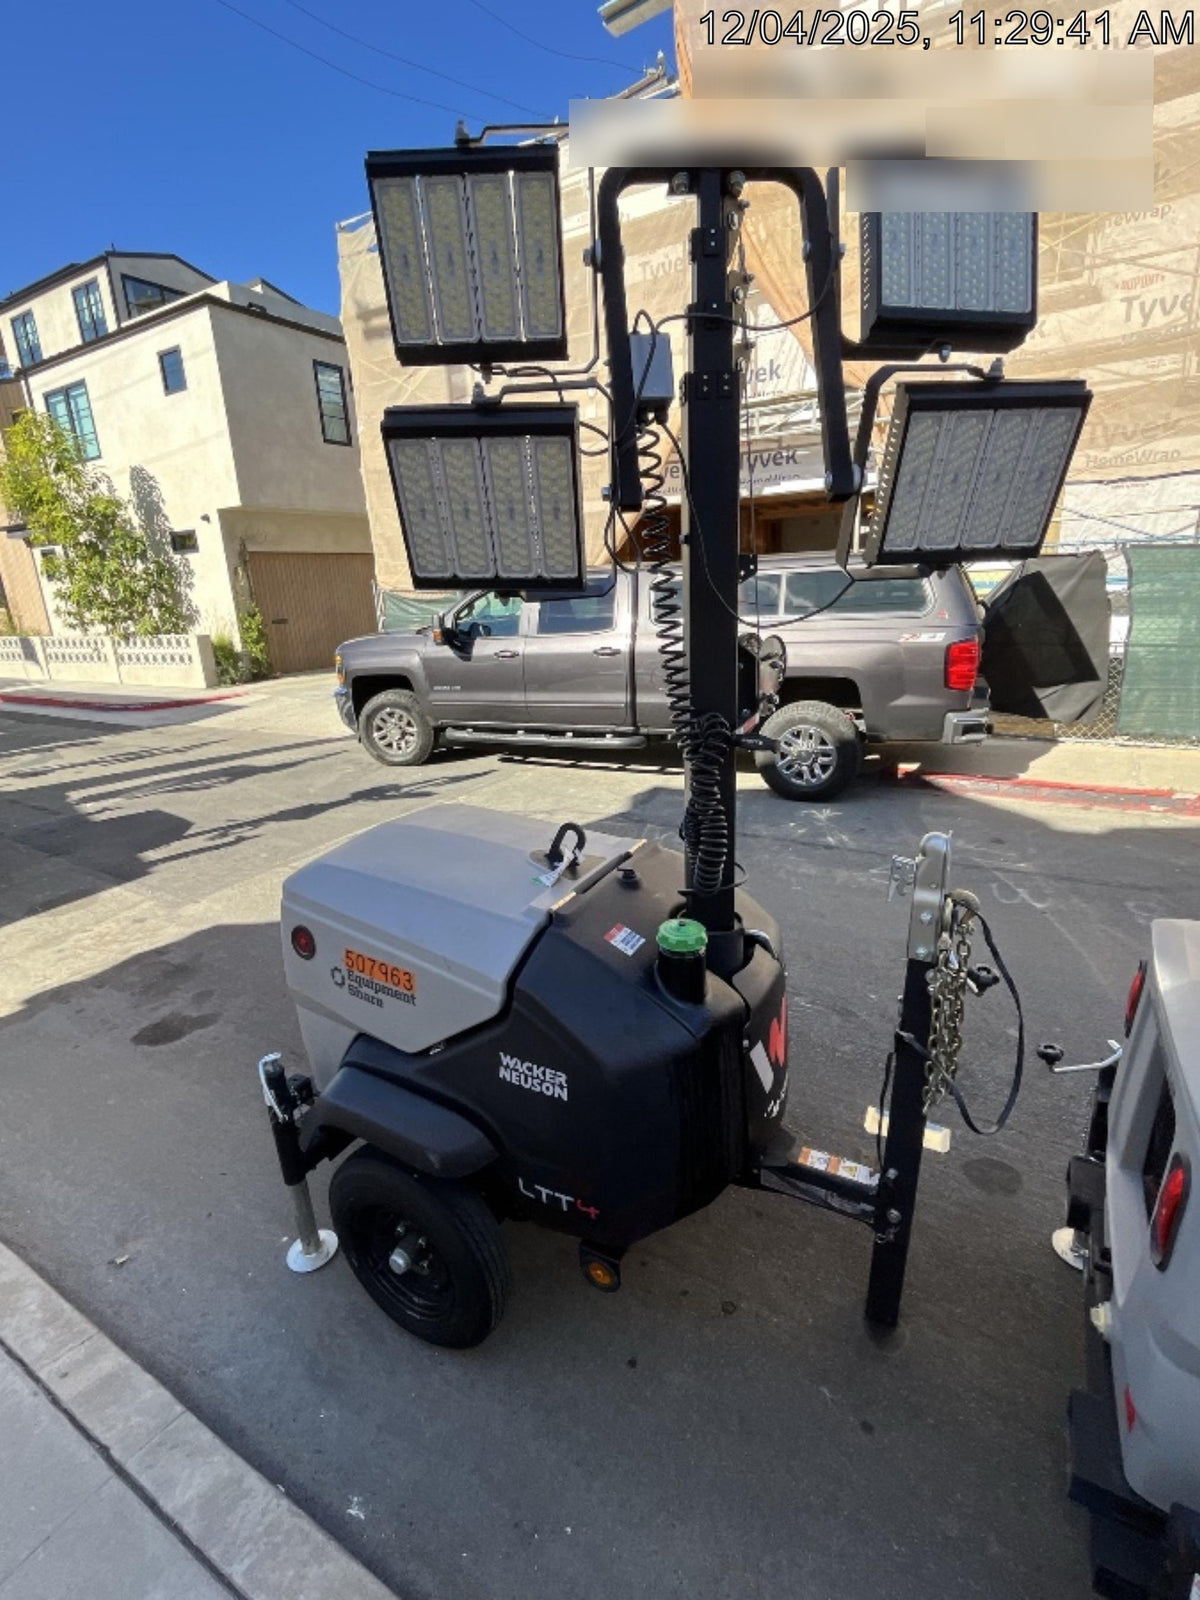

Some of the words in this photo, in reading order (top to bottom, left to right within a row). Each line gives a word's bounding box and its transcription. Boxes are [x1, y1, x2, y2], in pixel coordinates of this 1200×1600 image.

[639, 257, 684, 283] Tyve
[344, 949, 413, 991] 507963
[347, 969, 416, 1006] Equipment
[499, 1051, 567, 1087] WACKER
[499, 1066, 568, 1101] NEUSON
[518, 1176, 599, 1220] LTT4
